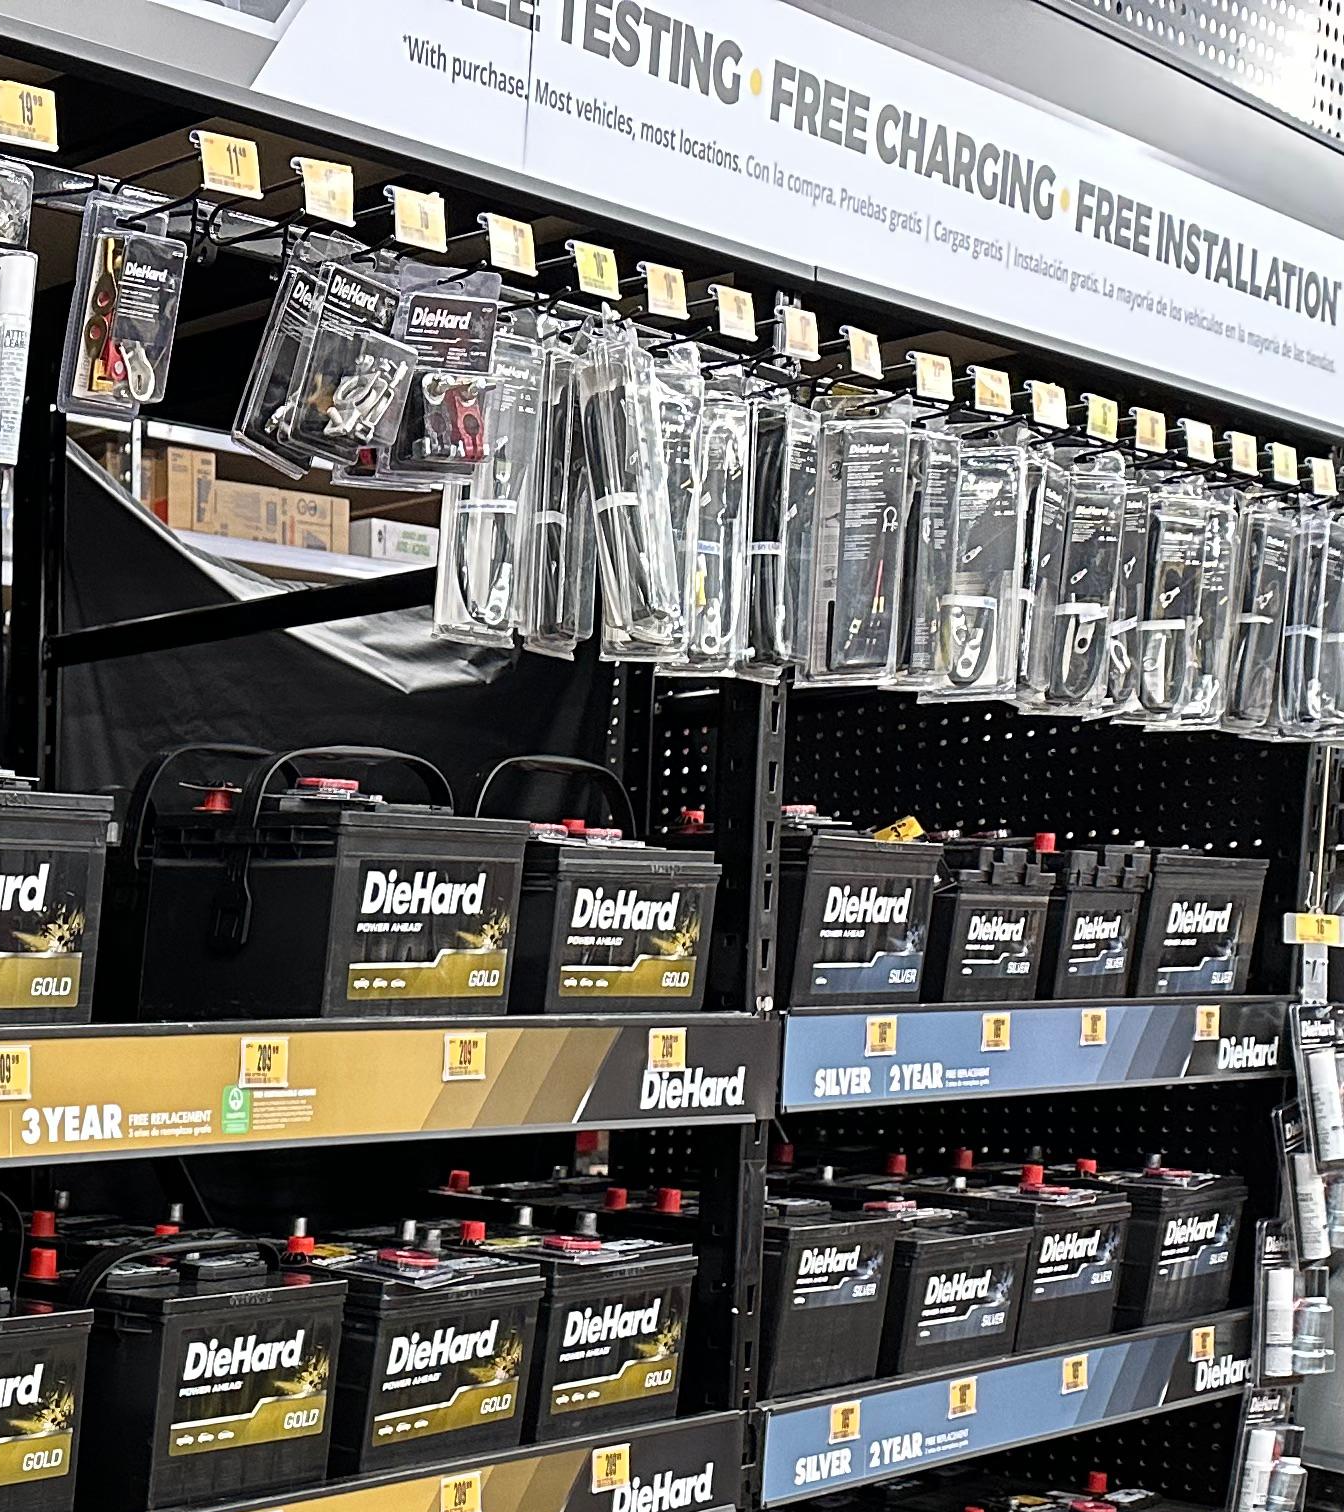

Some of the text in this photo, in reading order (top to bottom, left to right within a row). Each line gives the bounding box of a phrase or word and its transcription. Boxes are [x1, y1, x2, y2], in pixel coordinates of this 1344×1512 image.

[561, 0, 742, 105] TESTING
[451, 60, 530, 100] purchase.
[535, 79, 571, 115] Most
[575, 97, 635, 141] vehicles,
[640, 121, 675, 149] most
[679, 128, 742, 175] locations.
[769, 60, 1056, 221] FREE CHARGING
[745, 154, 922, 234] Con la compra. Pruebas gratis
[1075, 179, 1152, 257] FREE
[934, 220, 1002, 262] Cargas gratis
[125, 262, 166, 282] DieHard
[1103, 277, 1114, 298] La
[412, 305, 471, 329] DieHard
[361, 870, 486, 915] DieHard
[572, 887, 679, 930] DieHard
[824, 885, 912, 923] DieHard
[1166, 901, 1233, 934] DieHard
[31, 977, 71, 996] GOLD
[1218, 1036, 1278, 1070] DieHard
[640, 1067, 745, 1110] DieHard
[814, 1067, 871, 1097] SILVER
[890, 1062, 943, 1091] 2 YEAR
[21, 1103, 123, 1144] 3 YEAR
[129, 1109, 211, 1125] FREE REPLACEMENT
[799, 1245, 861, 1274] DieHard
[1039, 1229, 1100, 1264] DieHard
[386, 1319, 499, 1375] DieHard
[794, 1448, 852, 1486] SILVER
